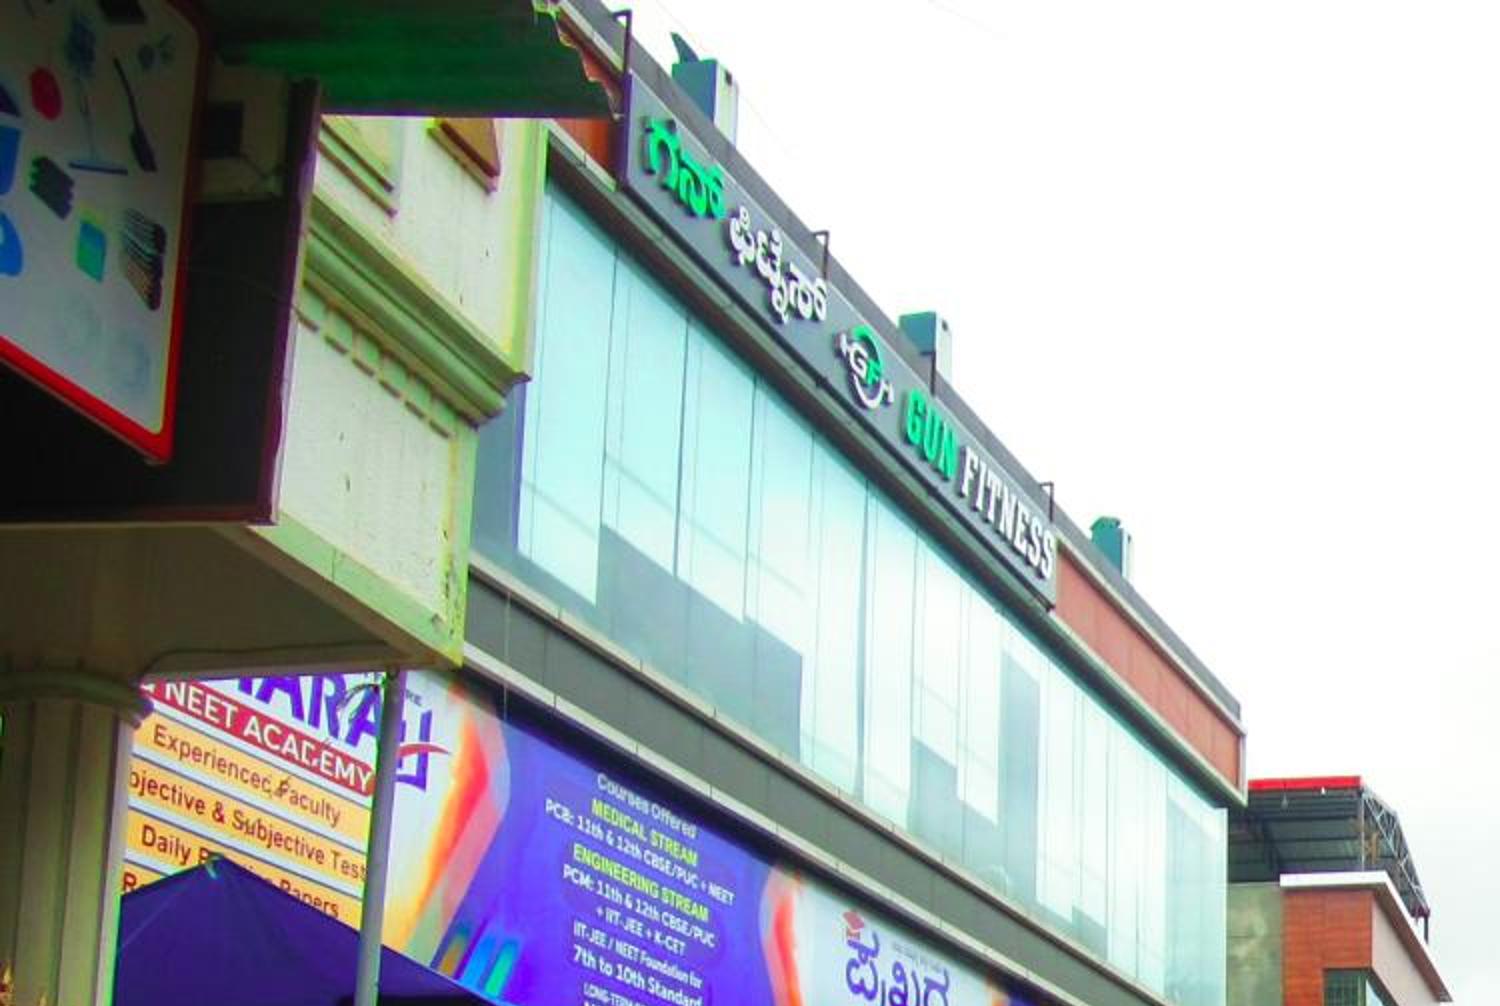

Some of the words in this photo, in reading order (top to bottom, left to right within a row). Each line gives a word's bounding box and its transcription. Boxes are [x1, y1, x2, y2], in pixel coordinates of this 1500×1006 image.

[906, 388, 958, 478] GUN
[961, 446, 1056, 580] FITNESS
[165, 682, 238, 729] NEET
[212, 800, 226, 824] &
[231, 809, 326, 865] Subjective
[591, 798, 648, 842] MEDICAL
[651, 830, 699, 867] STREAM
[597, 773, 649, 815] Courses
[651, 803, 698, 839] Offered
[141, 824, 192, 866] Daily
[577, 814, 604, 841] 11th
[617, 835, 643, 861] 12th
[707, 882, 736, 906] NEET
[573, 843, 661, 900] ENGINEERING
[660, 886, 710, 922] STREAM
[635, 898, 661, 923] 12th
[573, 944, 597, 970] 7th
[599, 957, 614, 977] to
[616, 963, 647, 991] 10th
